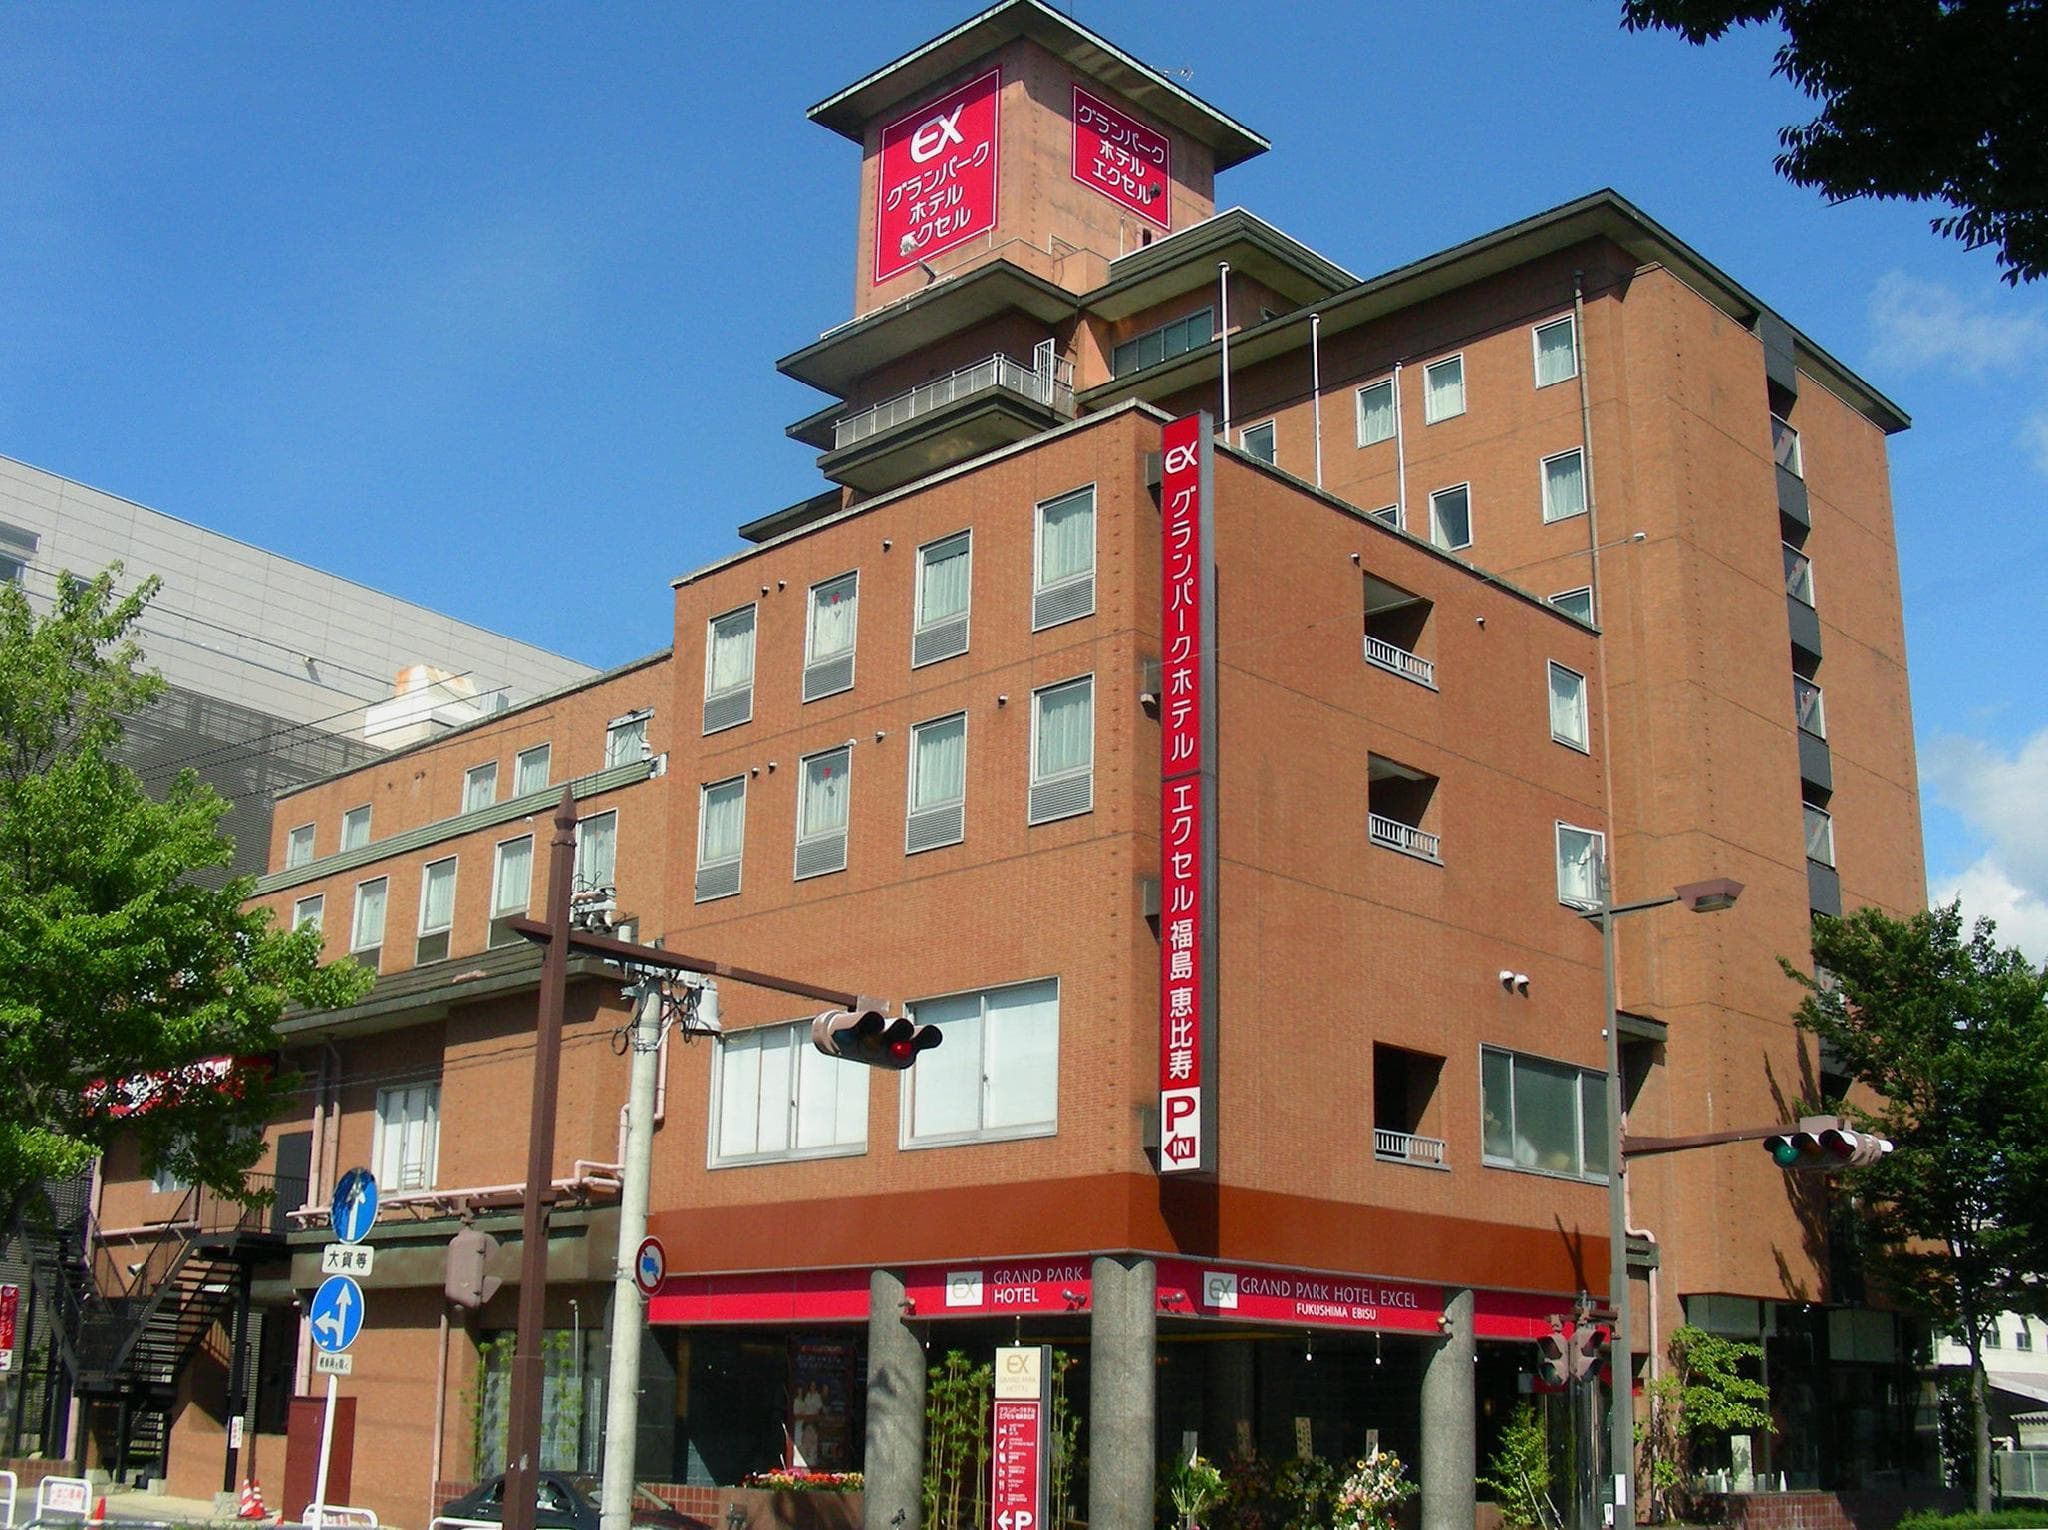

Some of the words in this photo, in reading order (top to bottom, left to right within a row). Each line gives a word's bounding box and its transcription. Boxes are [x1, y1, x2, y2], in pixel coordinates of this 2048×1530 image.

[910, 102, 966, 164] EX
[1078, 105, 1164, 164] グランパーク
[1099, 139, 1145, 178] ホテル
[886, 140, 989, 212] グランパーク
[1092, 157, 1152, 205] エクセル
[909, 183, 963, 225] ホテル
[1164, 440, 1198, 474] EX
[1166, 1097, 1196, 1132] P
[1172, 1142, 1190, 1157] IN
[952, 1278, 976, 1299] EX
[993, 1269, 1041, 1284] GRAND
[1046, 1267, 1083, 1281] PARK
[1209, 1278, 1232, 1301] EX
[994, 1287, 1039, 1303] HOTEL
[1241, 1277, 1290, 1297] GRAND
[1296, 1282, 1329, 1300] PARK
[1334, 1286, 1376, 1305] HOTEL
[1380, 1290, 1418, 1309] EXCEL
[1296, 1303, 1348, 1318] FUKUSHIMA
[1352, 1306, 1377, 1320] EBISU
[1015, 1510, 1033, 1530] P
